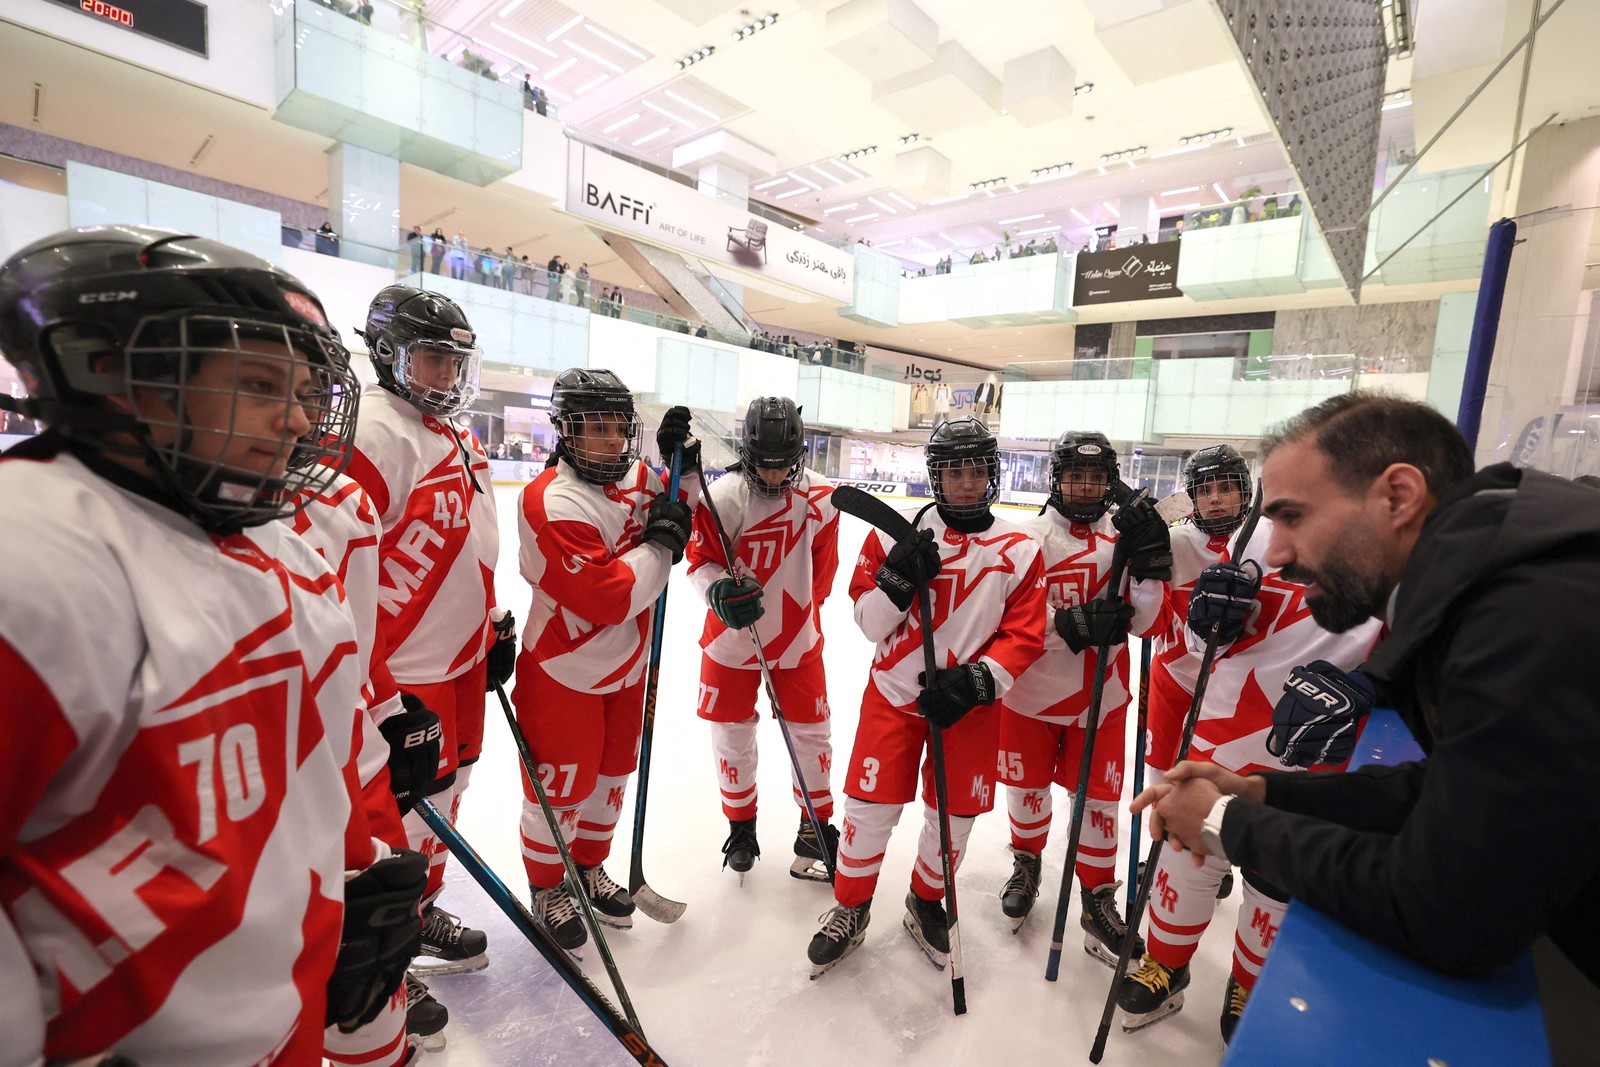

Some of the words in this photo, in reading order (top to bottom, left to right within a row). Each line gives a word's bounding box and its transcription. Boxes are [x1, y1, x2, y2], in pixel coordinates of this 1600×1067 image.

[82, 0, 130, 25] 20:00
[659, 222, 675, 234] ART
[677, 229, 688, 239] OF
[689, 233, 706, 245] LIFE
[786, 250, 810, 268] زندگی
[812, 260, 828, 273] هنر
[79, 291, 139, 304] CCM
[953, 443, 979, 451] BAUER
[433, 489, 467, 530] 42
[748, 540, 777, 570] 77
[1048, 581, 1079, 609] 45
[698, 681, 720, 714] 77
[859, 756, 880, 793] 3
[996, 749, 1025, 782] 45
[177, 722, 267, 847] 70
[538, 763, 578, 798] 27
